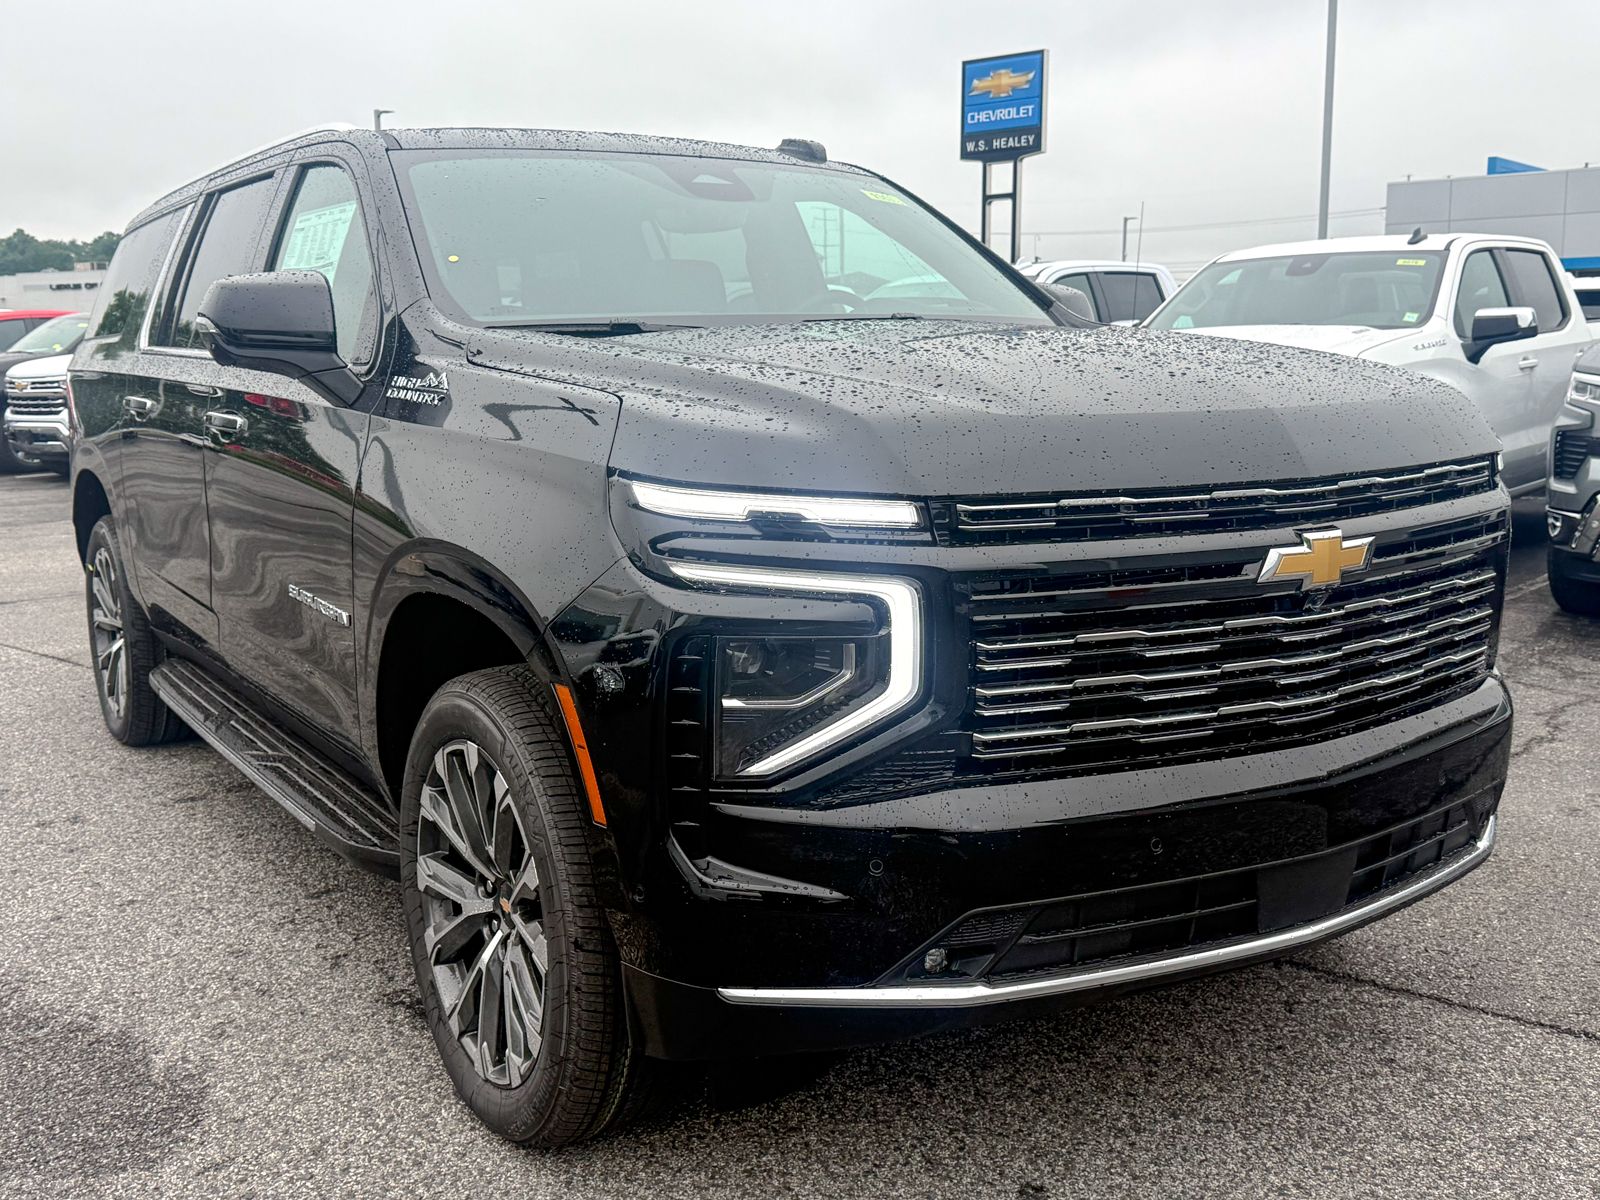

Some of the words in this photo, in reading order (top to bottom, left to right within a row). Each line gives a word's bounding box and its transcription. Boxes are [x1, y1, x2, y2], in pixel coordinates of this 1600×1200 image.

[967, 105, 1035, 124] CHEVROLET
[966, 140, 989, 152] W.S.
[992, 134, 1035, 150] HEALEY
